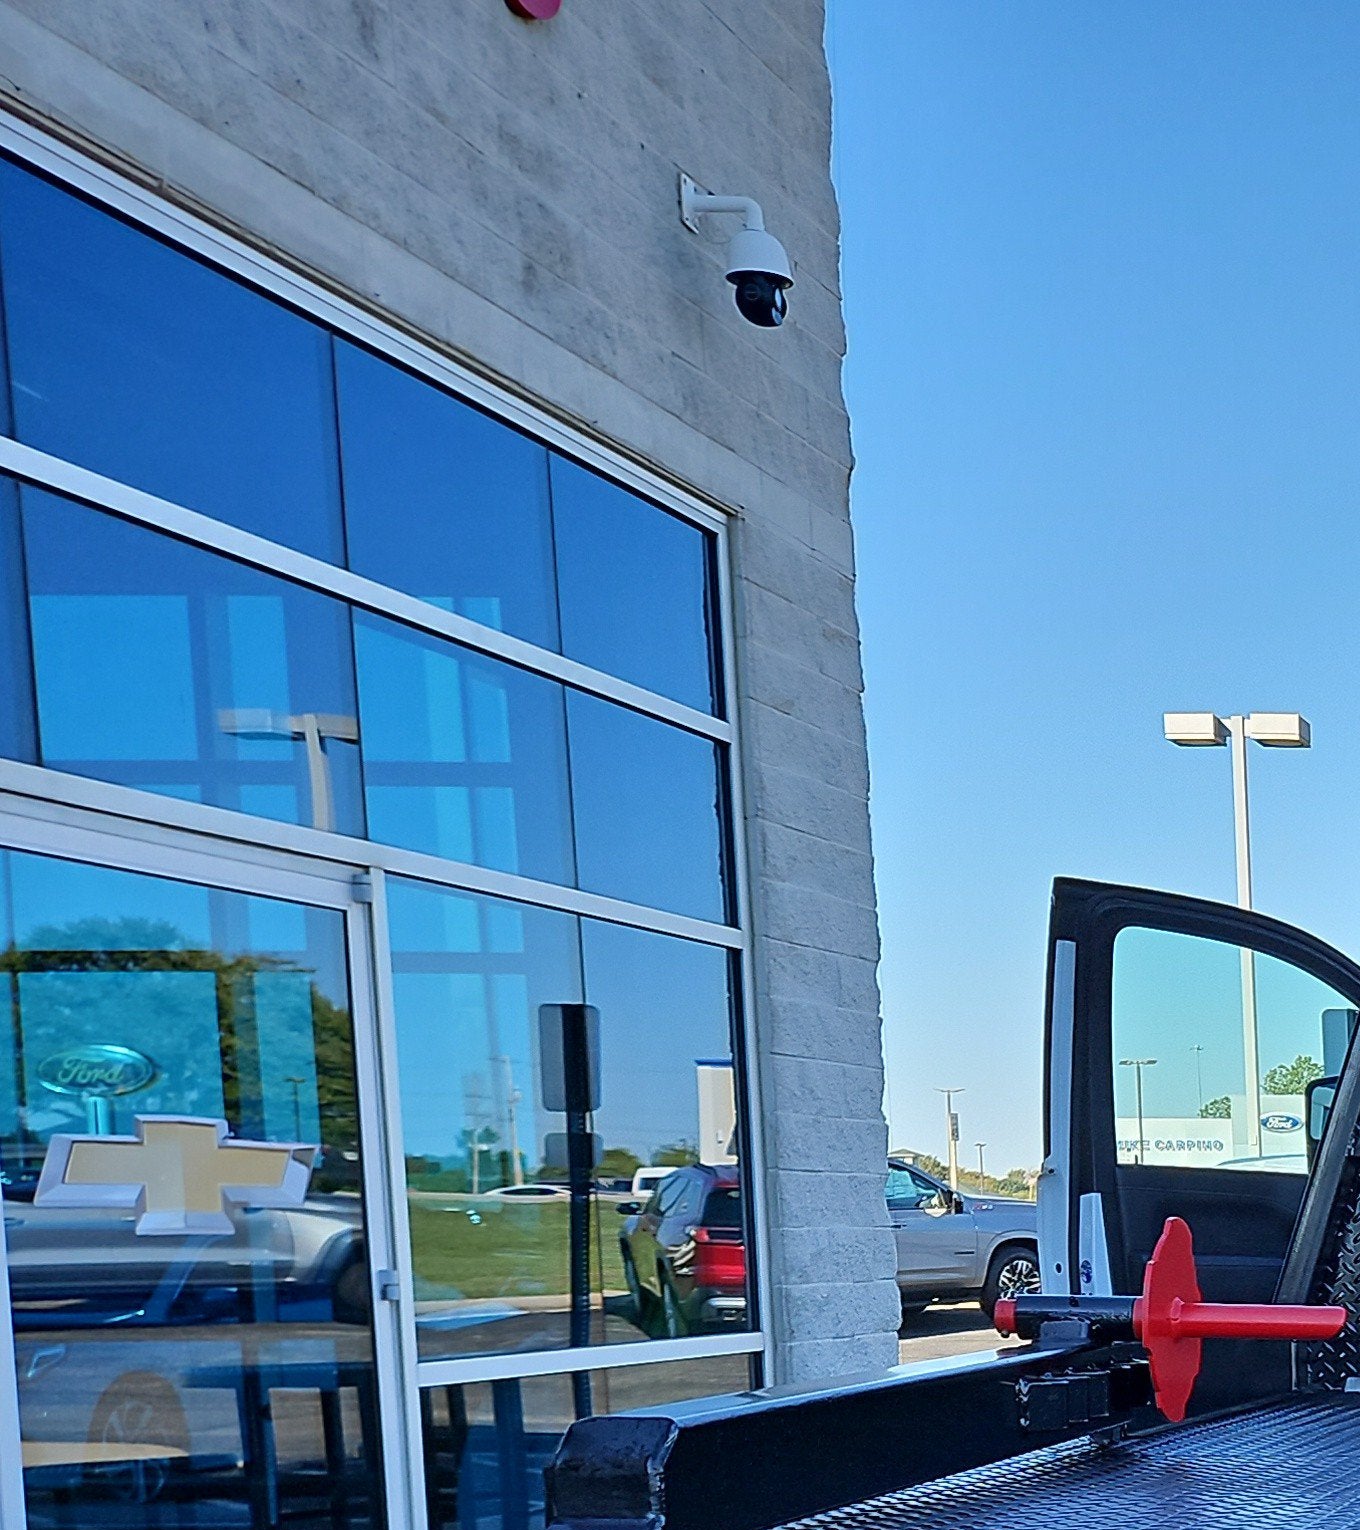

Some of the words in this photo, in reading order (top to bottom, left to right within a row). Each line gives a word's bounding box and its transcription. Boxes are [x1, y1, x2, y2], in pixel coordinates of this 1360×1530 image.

[58, 1056, 125, 1083] Ford
[1266, 1117, 1293, 1129] Ford
[1154, 1139, 1224, 1152] CARPINO
